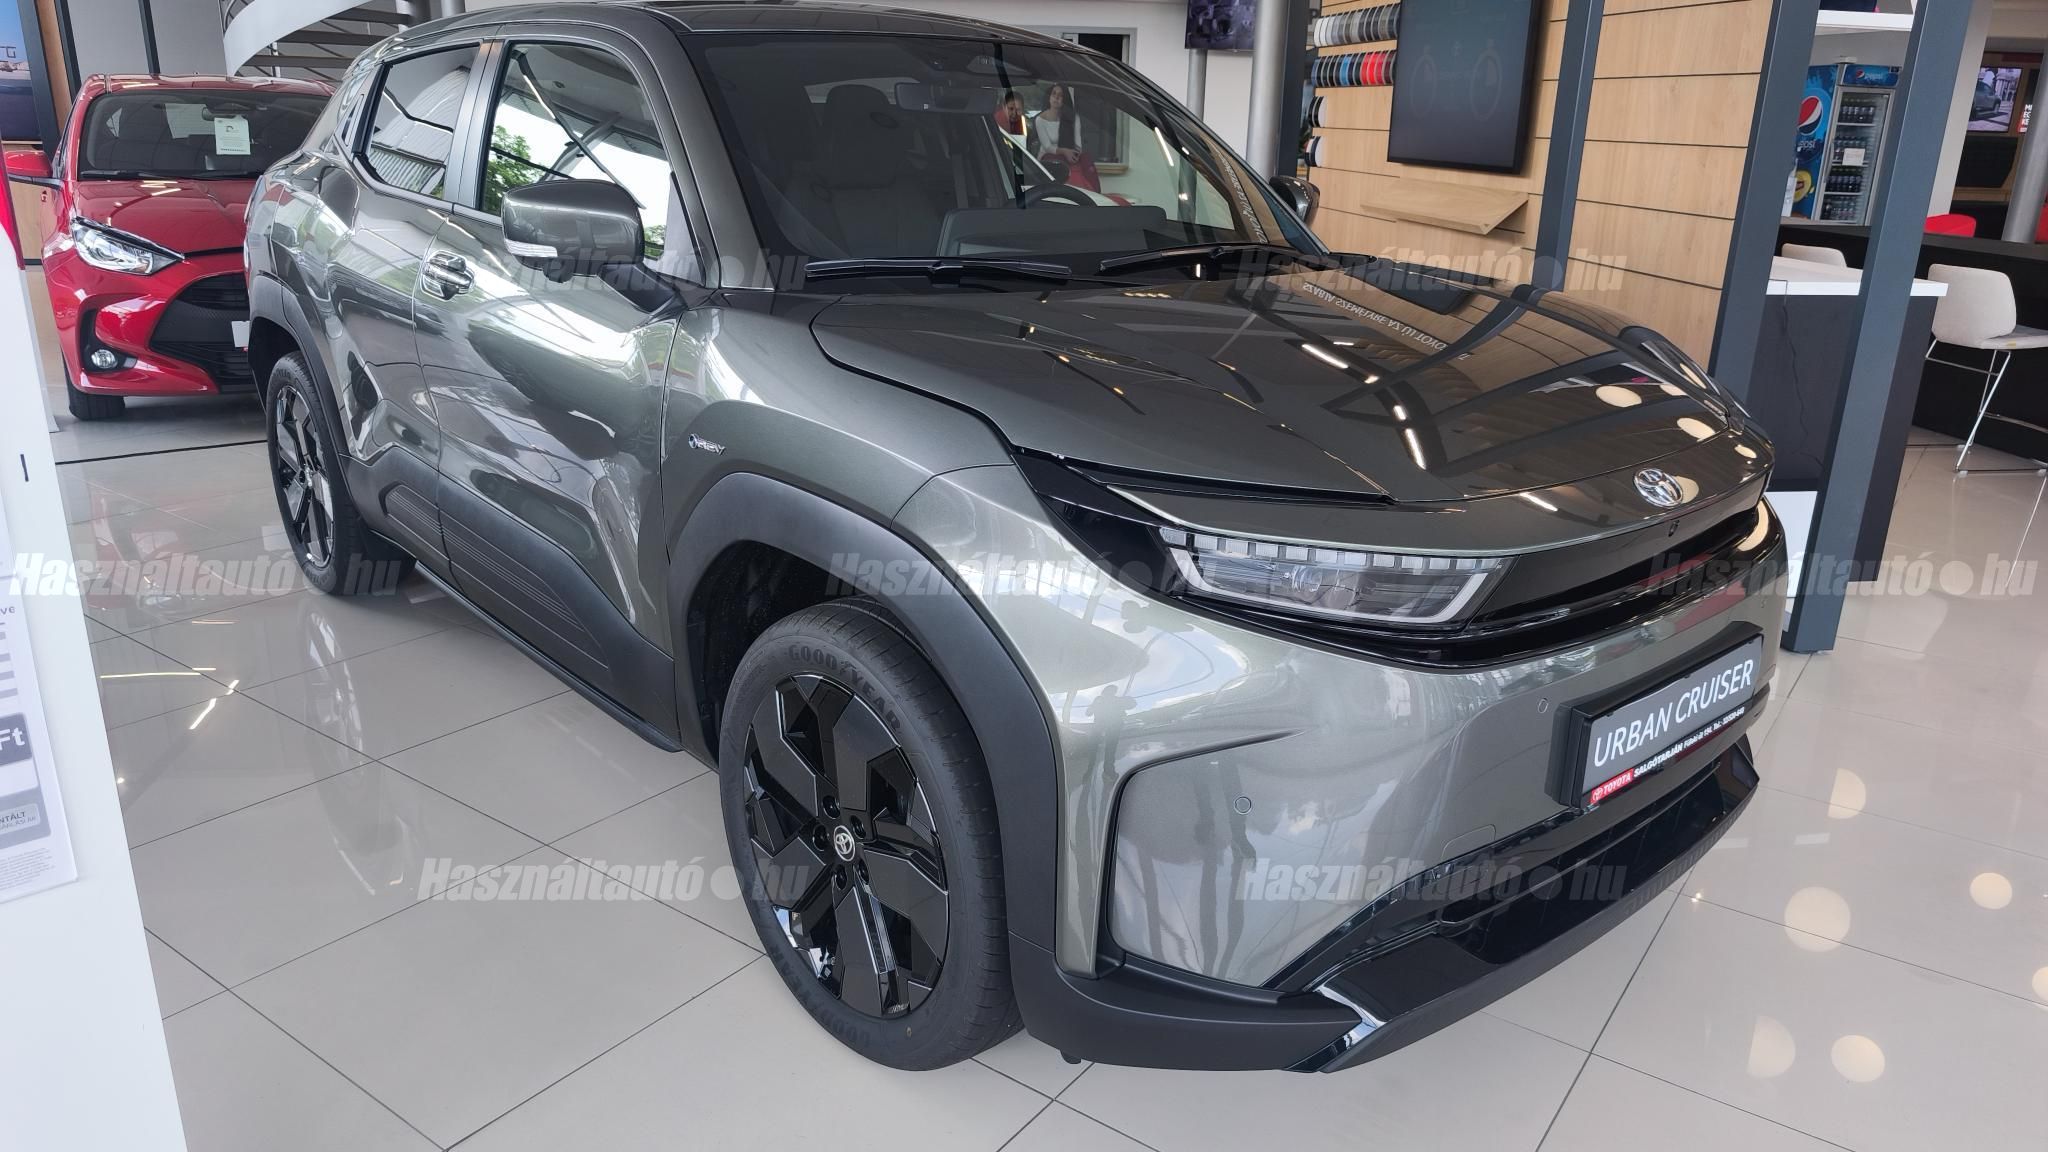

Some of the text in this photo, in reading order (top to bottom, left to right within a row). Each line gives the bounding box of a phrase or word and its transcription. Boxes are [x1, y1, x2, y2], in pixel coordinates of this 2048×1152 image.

[1593, 659, 1754, 767] URBAN CRUISER
[1603, 772, 1632, 796] TOYOTA
